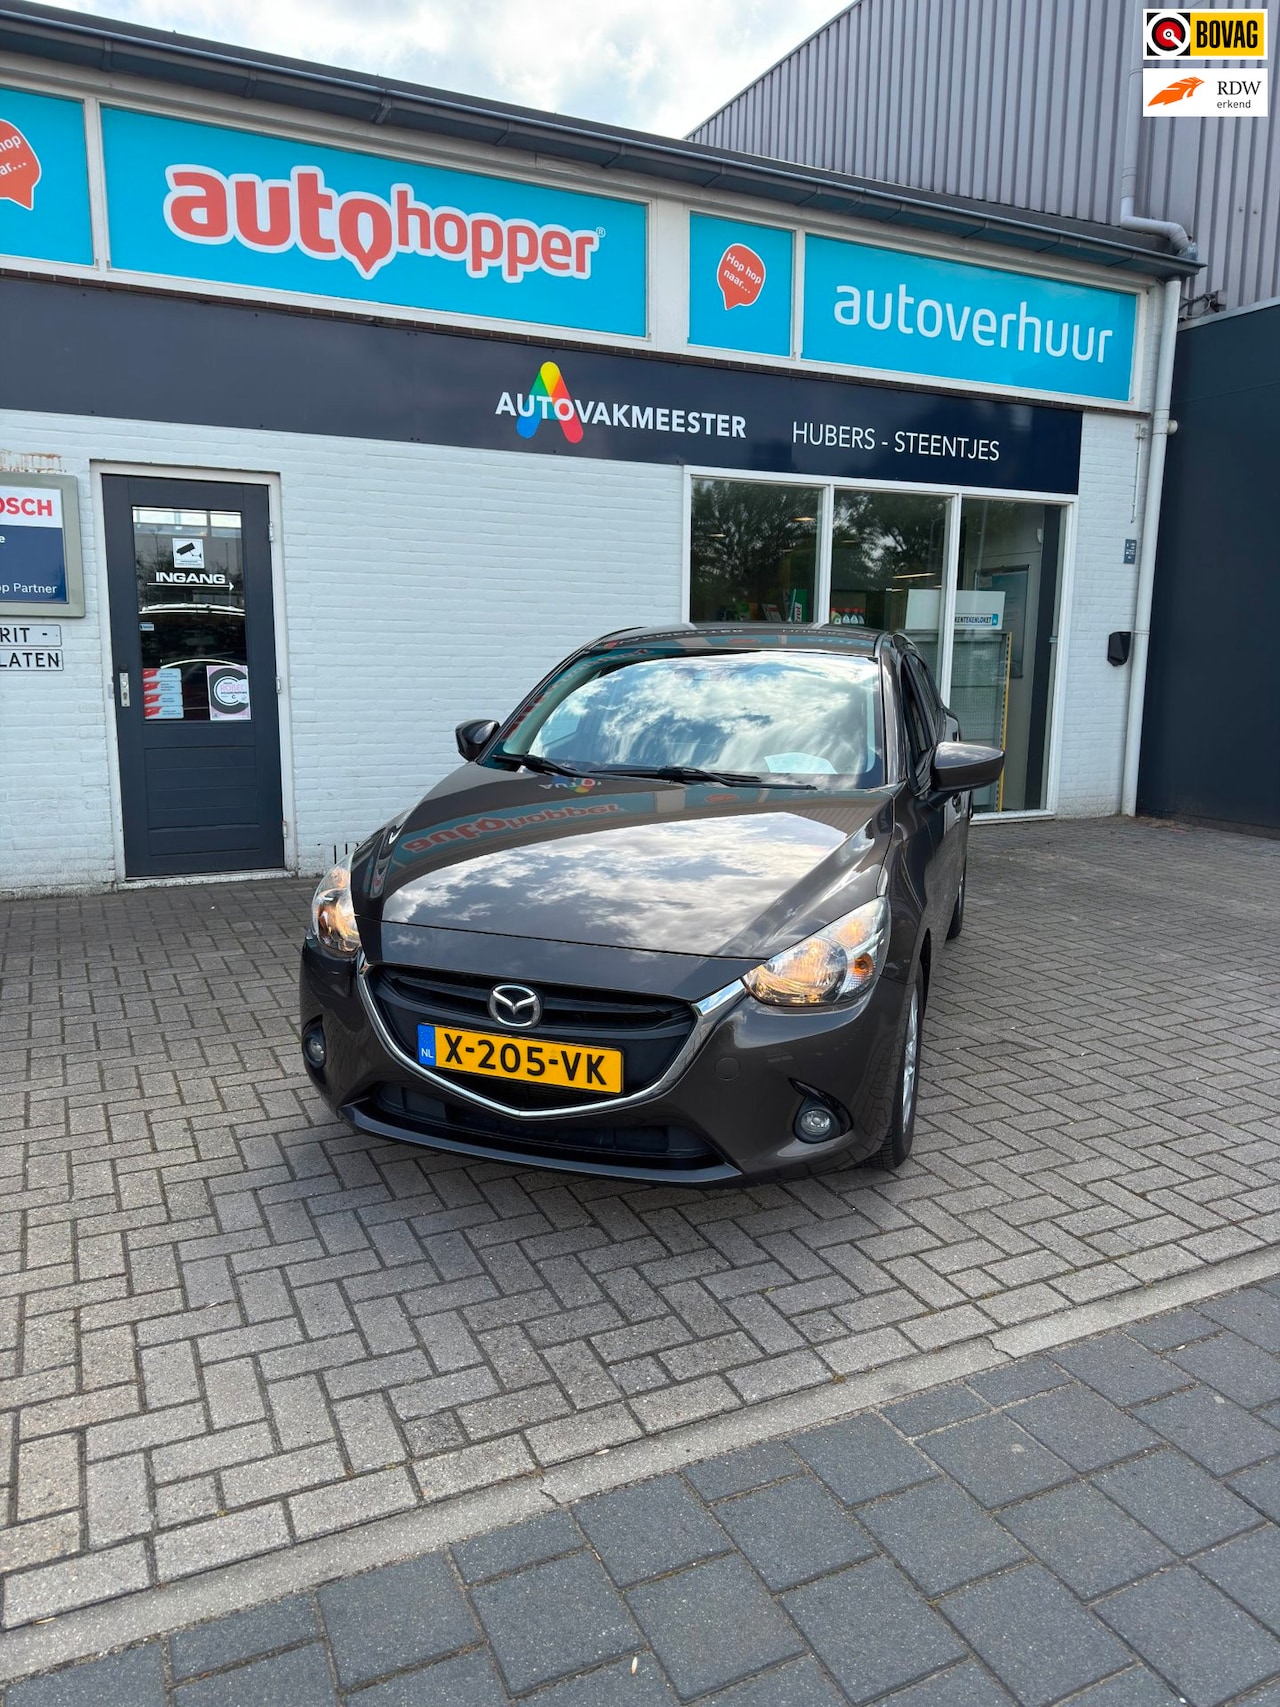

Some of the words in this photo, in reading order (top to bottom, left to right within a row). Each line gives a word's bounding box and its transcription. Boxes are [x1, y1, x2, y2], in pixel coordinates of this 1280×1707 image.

[165, 166, 597, 281] autohopper
[723, 270, 751, 294] naar...
[726, 252, 745, 272] Hop
[745, 266, 762, 284] hop
[834, 284, 1113, 363] autoverhuur
[495, 391, 747, 438] AUTOVAKMEESTER
[793, 421, 875, 449] HUBERS
[894, 431, 1000, 461] STEENTJES
[13, 582, 57, 594] Partner
[156, 571, 226, 584] INGANG
[421, 1047, 434, 1059] NL
[444, 1033, 607, 1085] X-205-VK
